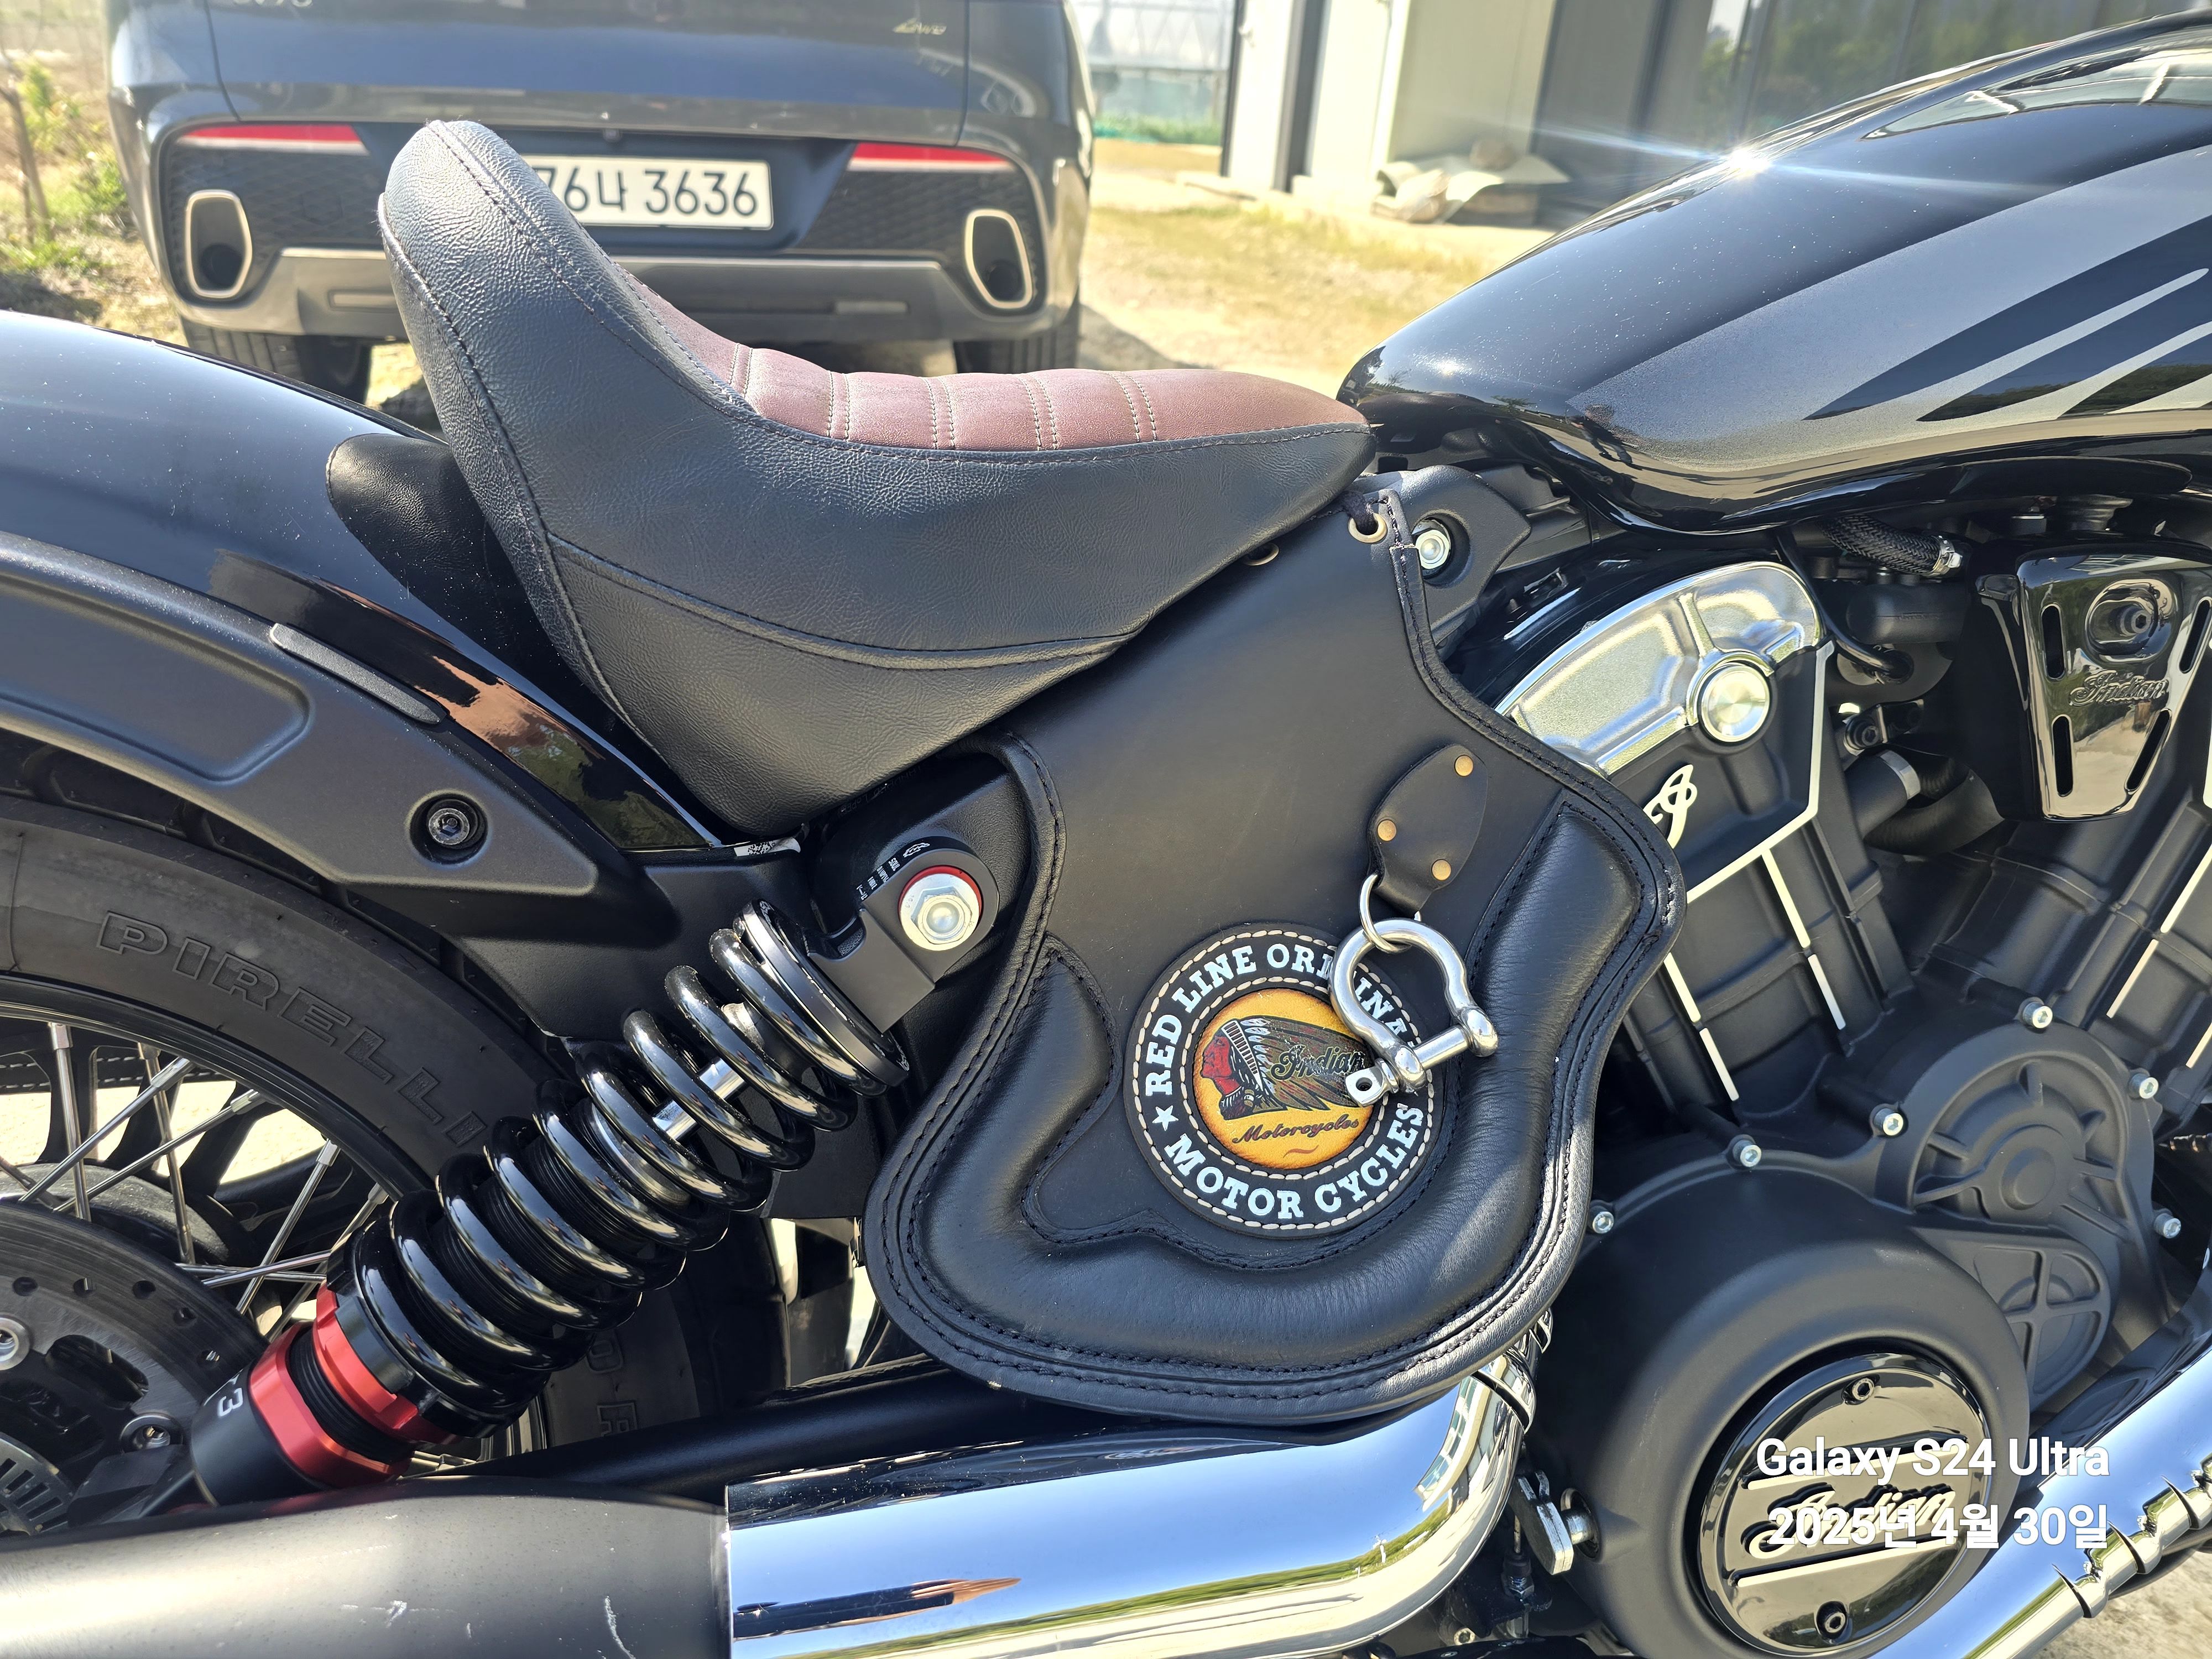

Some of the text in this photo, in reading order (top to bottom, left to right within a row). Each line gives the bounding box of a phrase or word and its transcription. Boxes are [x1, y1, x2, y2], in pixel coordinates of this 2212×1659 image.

[644, 170, 758, 217] 3636
[2069, 669, 2169, 706] Indian
[95, 910, 488, 1147] PIRELLI
[1145, 943, 1415, 1096] RED LINE ORIINA
[1270, 1044, 1365, 1081] Indian
[1232, 1113, 1359, 1144] Motorcycles
[1165, 1103, 1424, 1219] MOTOR CYCLES
